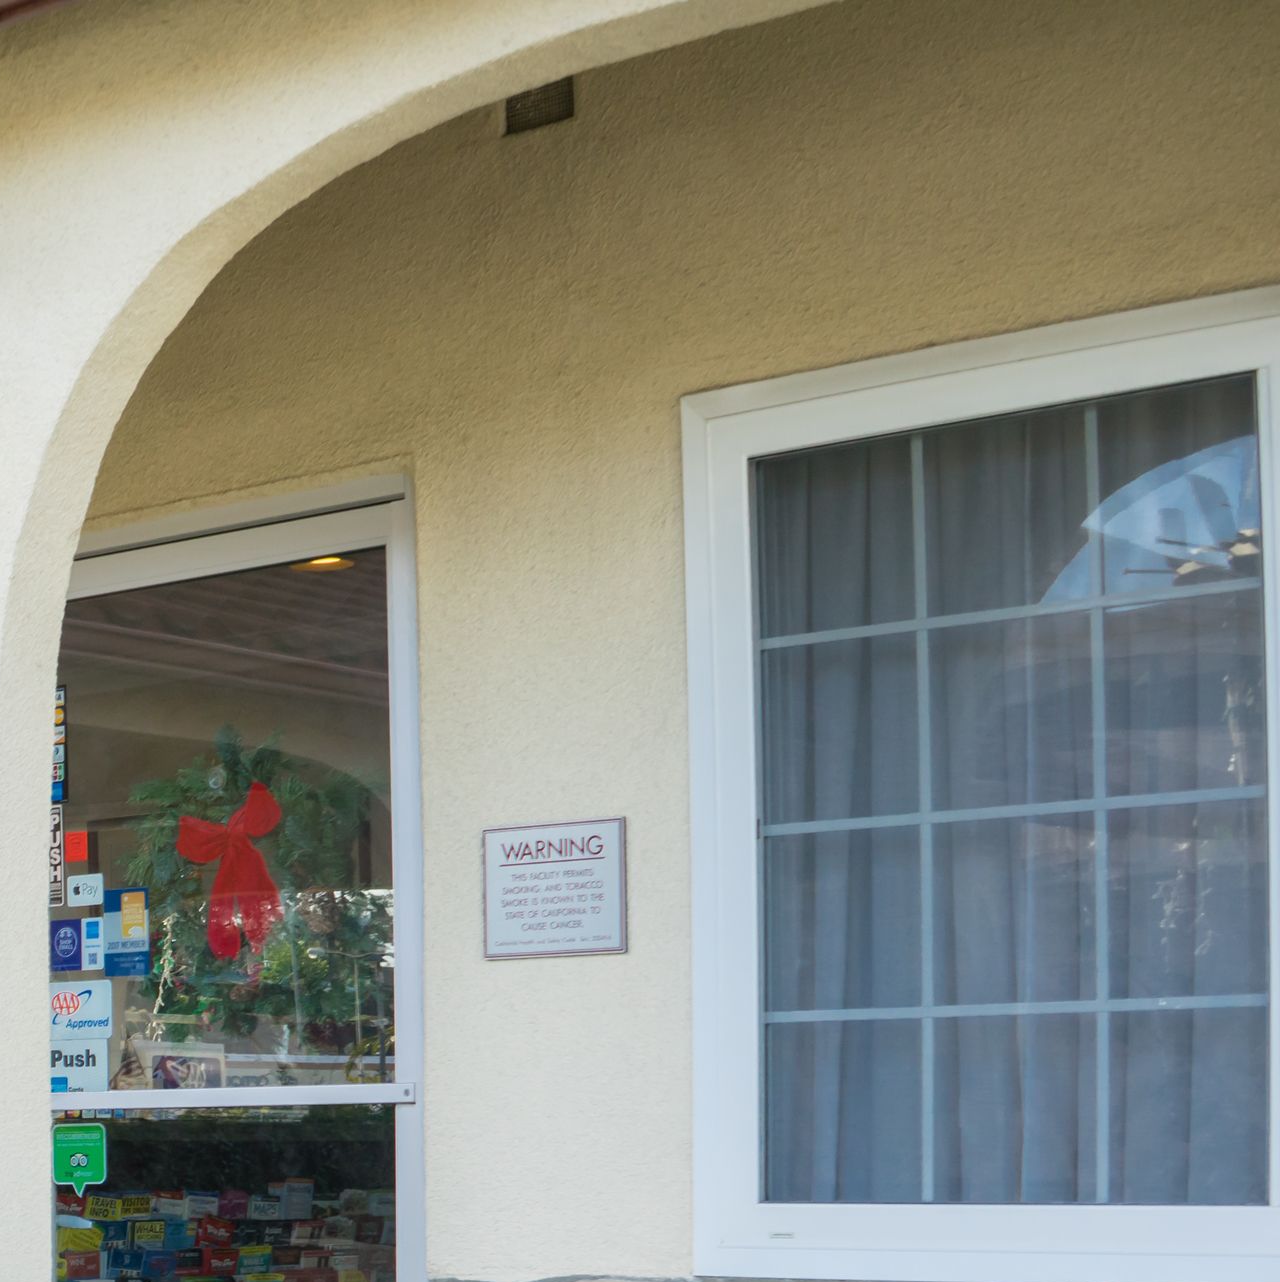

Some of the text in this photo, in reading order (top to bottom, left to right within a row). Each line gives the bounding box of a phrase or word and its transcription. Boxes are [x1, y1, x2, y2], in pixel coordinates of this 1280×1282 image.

[500, 834, 605, 862] WARNING
[82, 881, 99, 898] Pay
[52, 992, 79, 1015] AAA
[65, 1016, 109, 1029] Approved
[50, 1048, 97, 1068] Push
[91, 1196, 117, 1209] TRAVEL
[121, 1197, 150, 1208] VISITOR
[89, 1207, 109, 1218] INFO
[136, 1222, 164, 1234] WHALE
